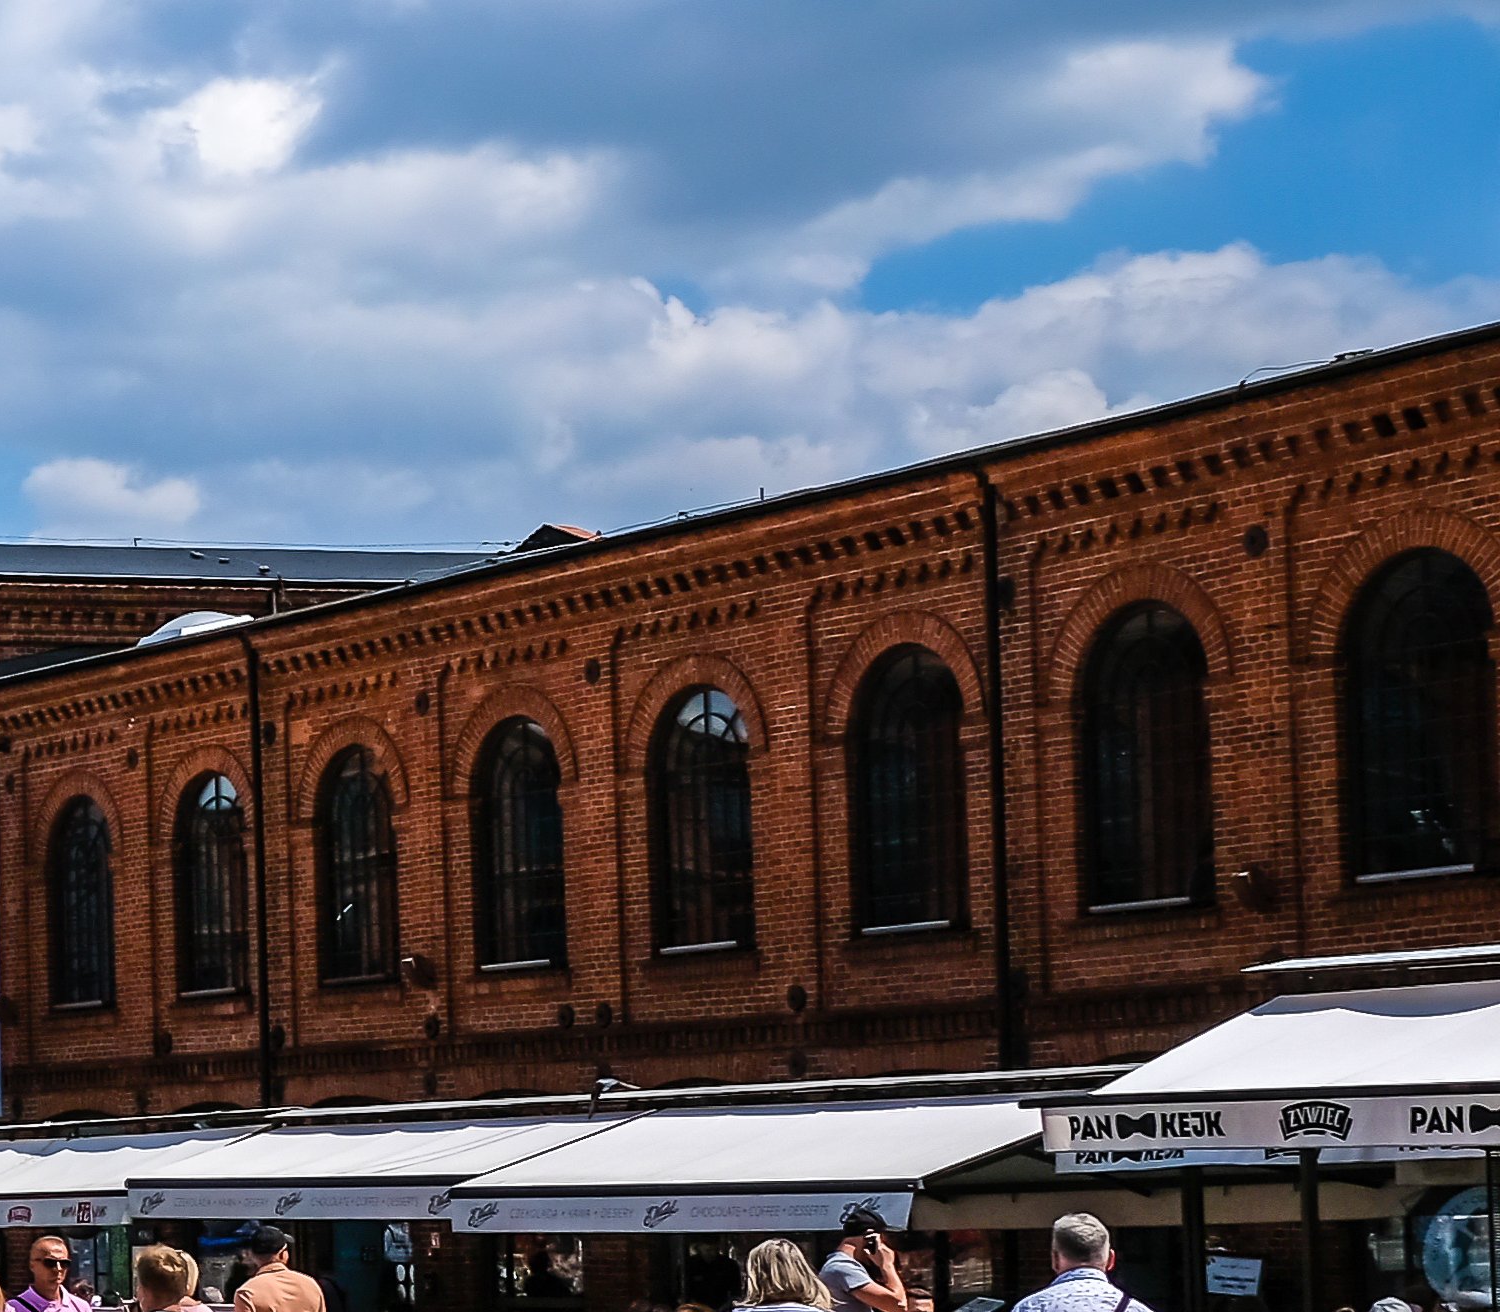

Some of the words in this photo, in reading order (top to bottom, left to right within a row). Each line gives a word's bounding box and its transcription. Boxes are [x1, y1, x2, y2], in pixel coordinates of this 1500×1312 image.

[1068, 1115, 1113, 1141] PAN
[1160, 1111, 1226, 1138] KEJK
[1410, 1105, 1465, 1134] PAN
